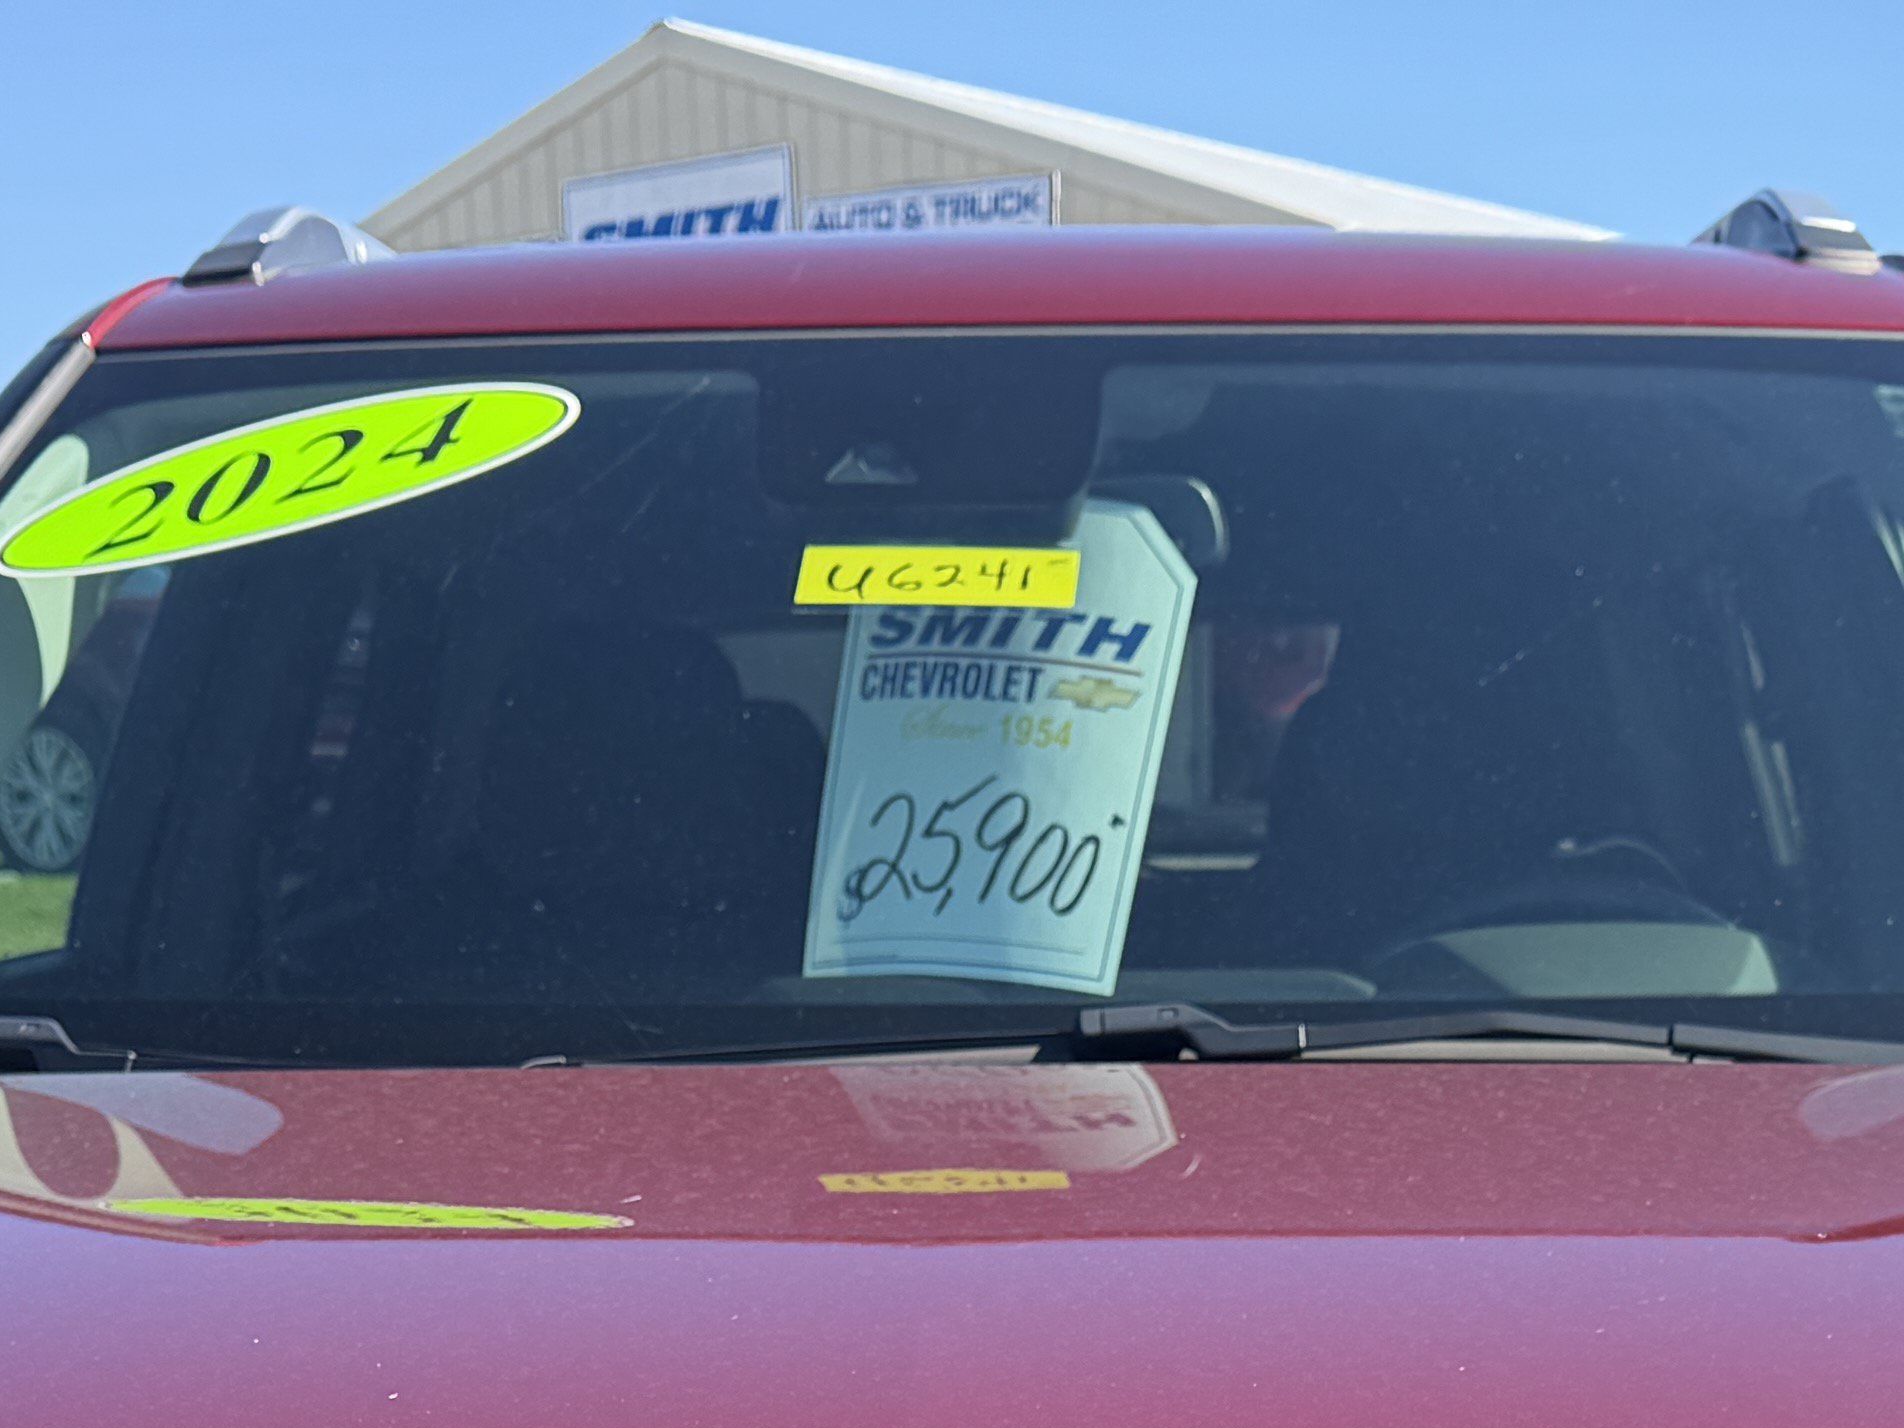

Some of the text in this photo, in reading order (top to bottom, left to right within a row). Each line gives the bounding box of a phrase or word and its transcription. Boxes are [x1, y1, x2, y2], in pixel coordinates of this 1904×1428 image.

[811, 203, 893, 230] AUTO
[934, 189, 1039, 220] TRUCK
[82, 397, 474, 561] 2024
[869, 606, 1151, 662] SMITH
[860, 662, 1044, 704] CHEVROLET
[1001, 713, 1073, 749] 1954
